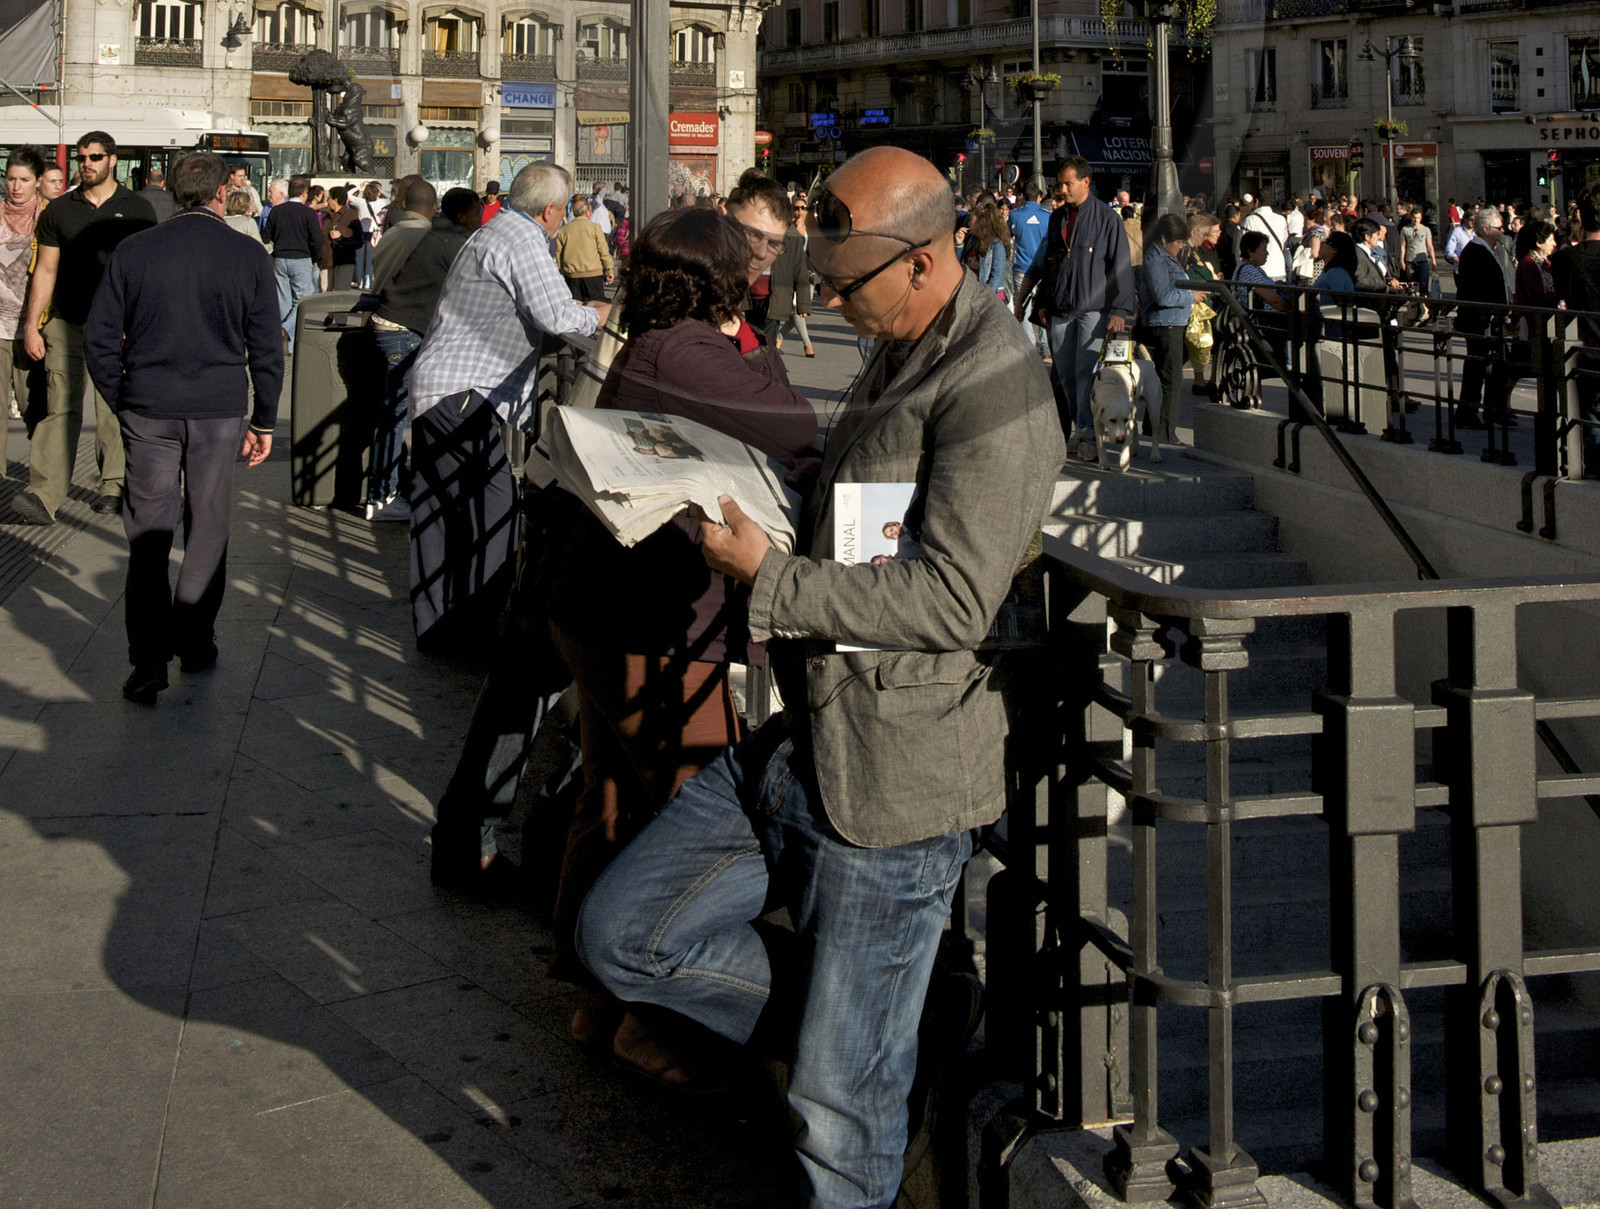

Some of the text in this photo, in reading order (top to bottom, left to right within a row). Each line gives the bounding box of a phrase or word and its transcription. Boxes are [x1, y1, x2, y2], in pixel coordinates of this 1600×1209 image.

[504, 93, 553, 104] CHANGE
[670, 120, 714, 133] Cremades
[1540, 127, 1600, 140] SEPHO
[1103, 149, 1151, 161] NACION
[1313, 148, 1348, 160] SOUVENI
